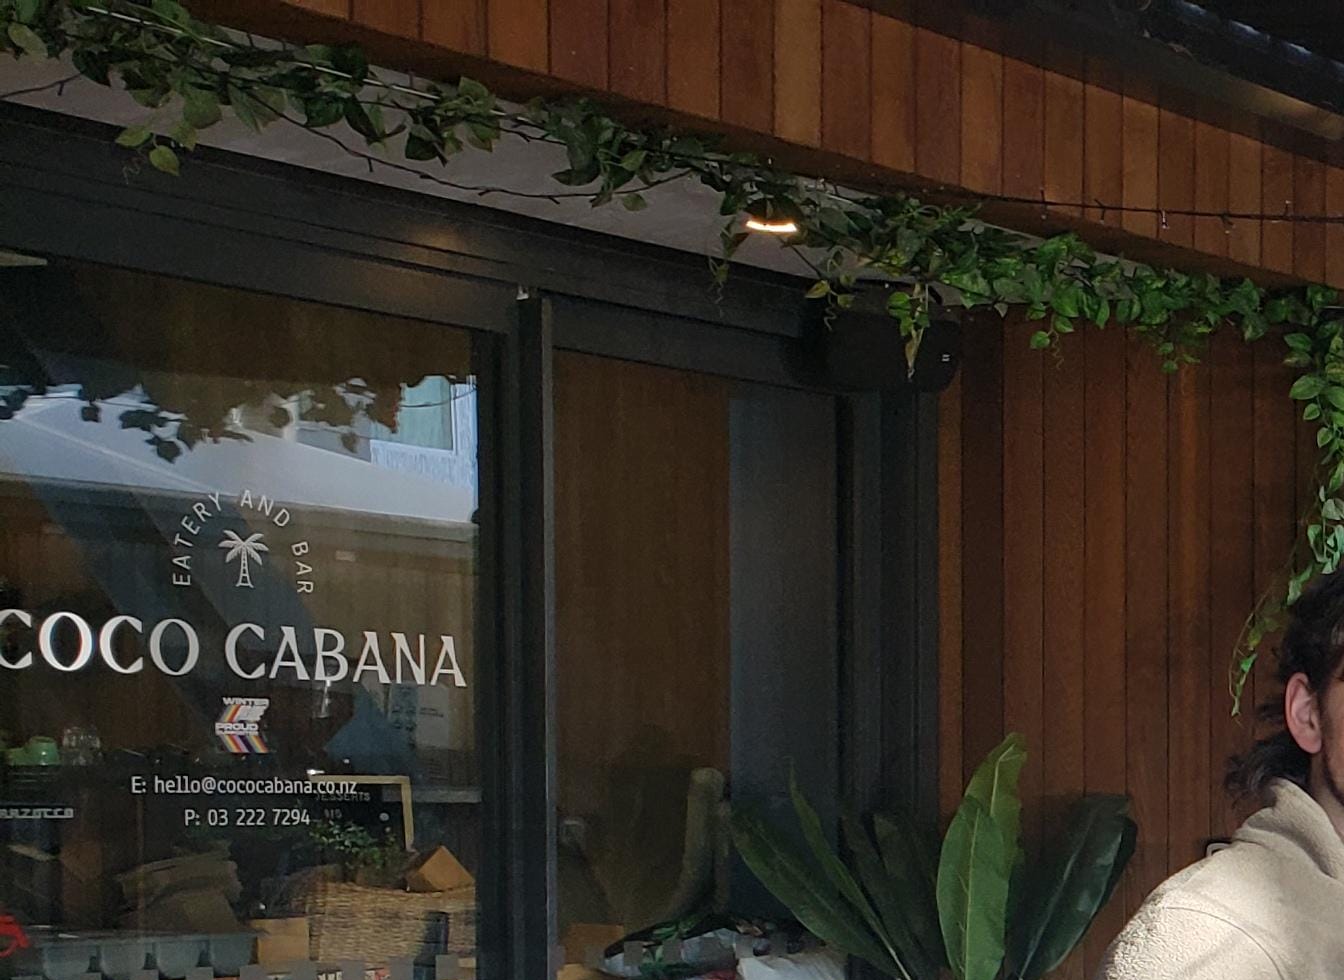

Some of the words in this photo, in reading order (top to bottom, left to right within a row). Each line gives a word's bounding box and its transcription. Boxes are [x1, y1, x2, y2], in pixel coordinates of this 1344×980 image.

[172, 492, 222, 586] EATERY
[240, 489, 290, 527] AND
[291, 541, 314, 593] BAR
[0, 608, 200, 676] COCO
[224, 622, 467, 688] CABANA
[215, 722, 258, 731] PROUD
[131, 778, 147, 793] E:
[153, 775, 357, 795] hello@cococabana.co.nz
[184, 810, 200, 825] P:
[207, 810, 230, 827] 03
[235, 809, 266, 826] 222
[271, 808, 310, 825] 7294
